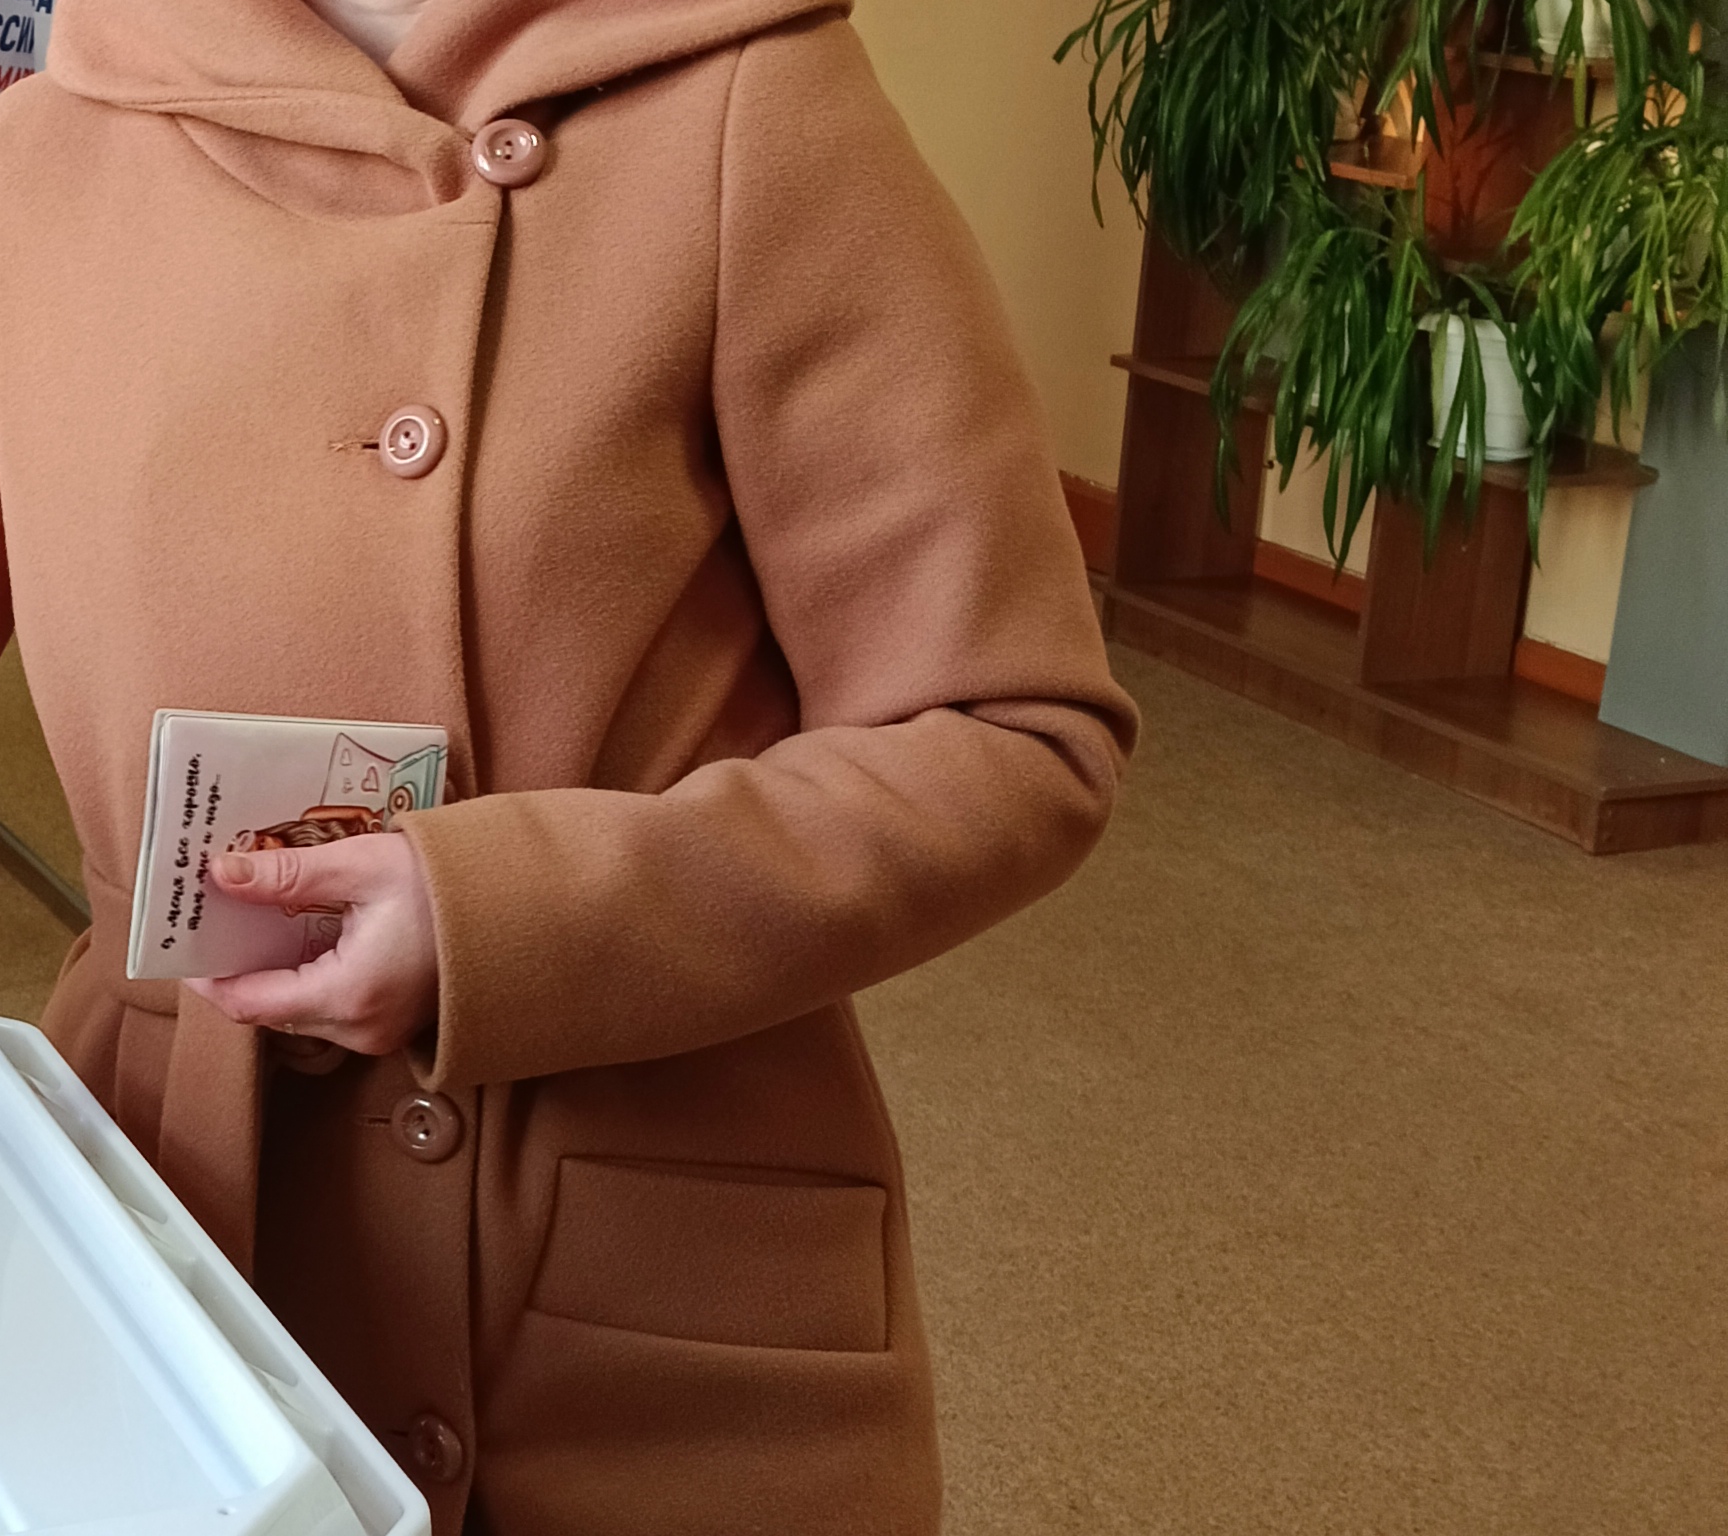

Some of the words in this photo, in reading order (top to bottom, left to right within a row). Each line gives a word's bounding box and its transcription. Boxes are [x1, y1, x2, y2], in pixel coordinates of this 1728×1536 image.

[202, 831, 214, 845] и
[196, 849, 210, 885] мне
[166, 875, 185, 929] меня
